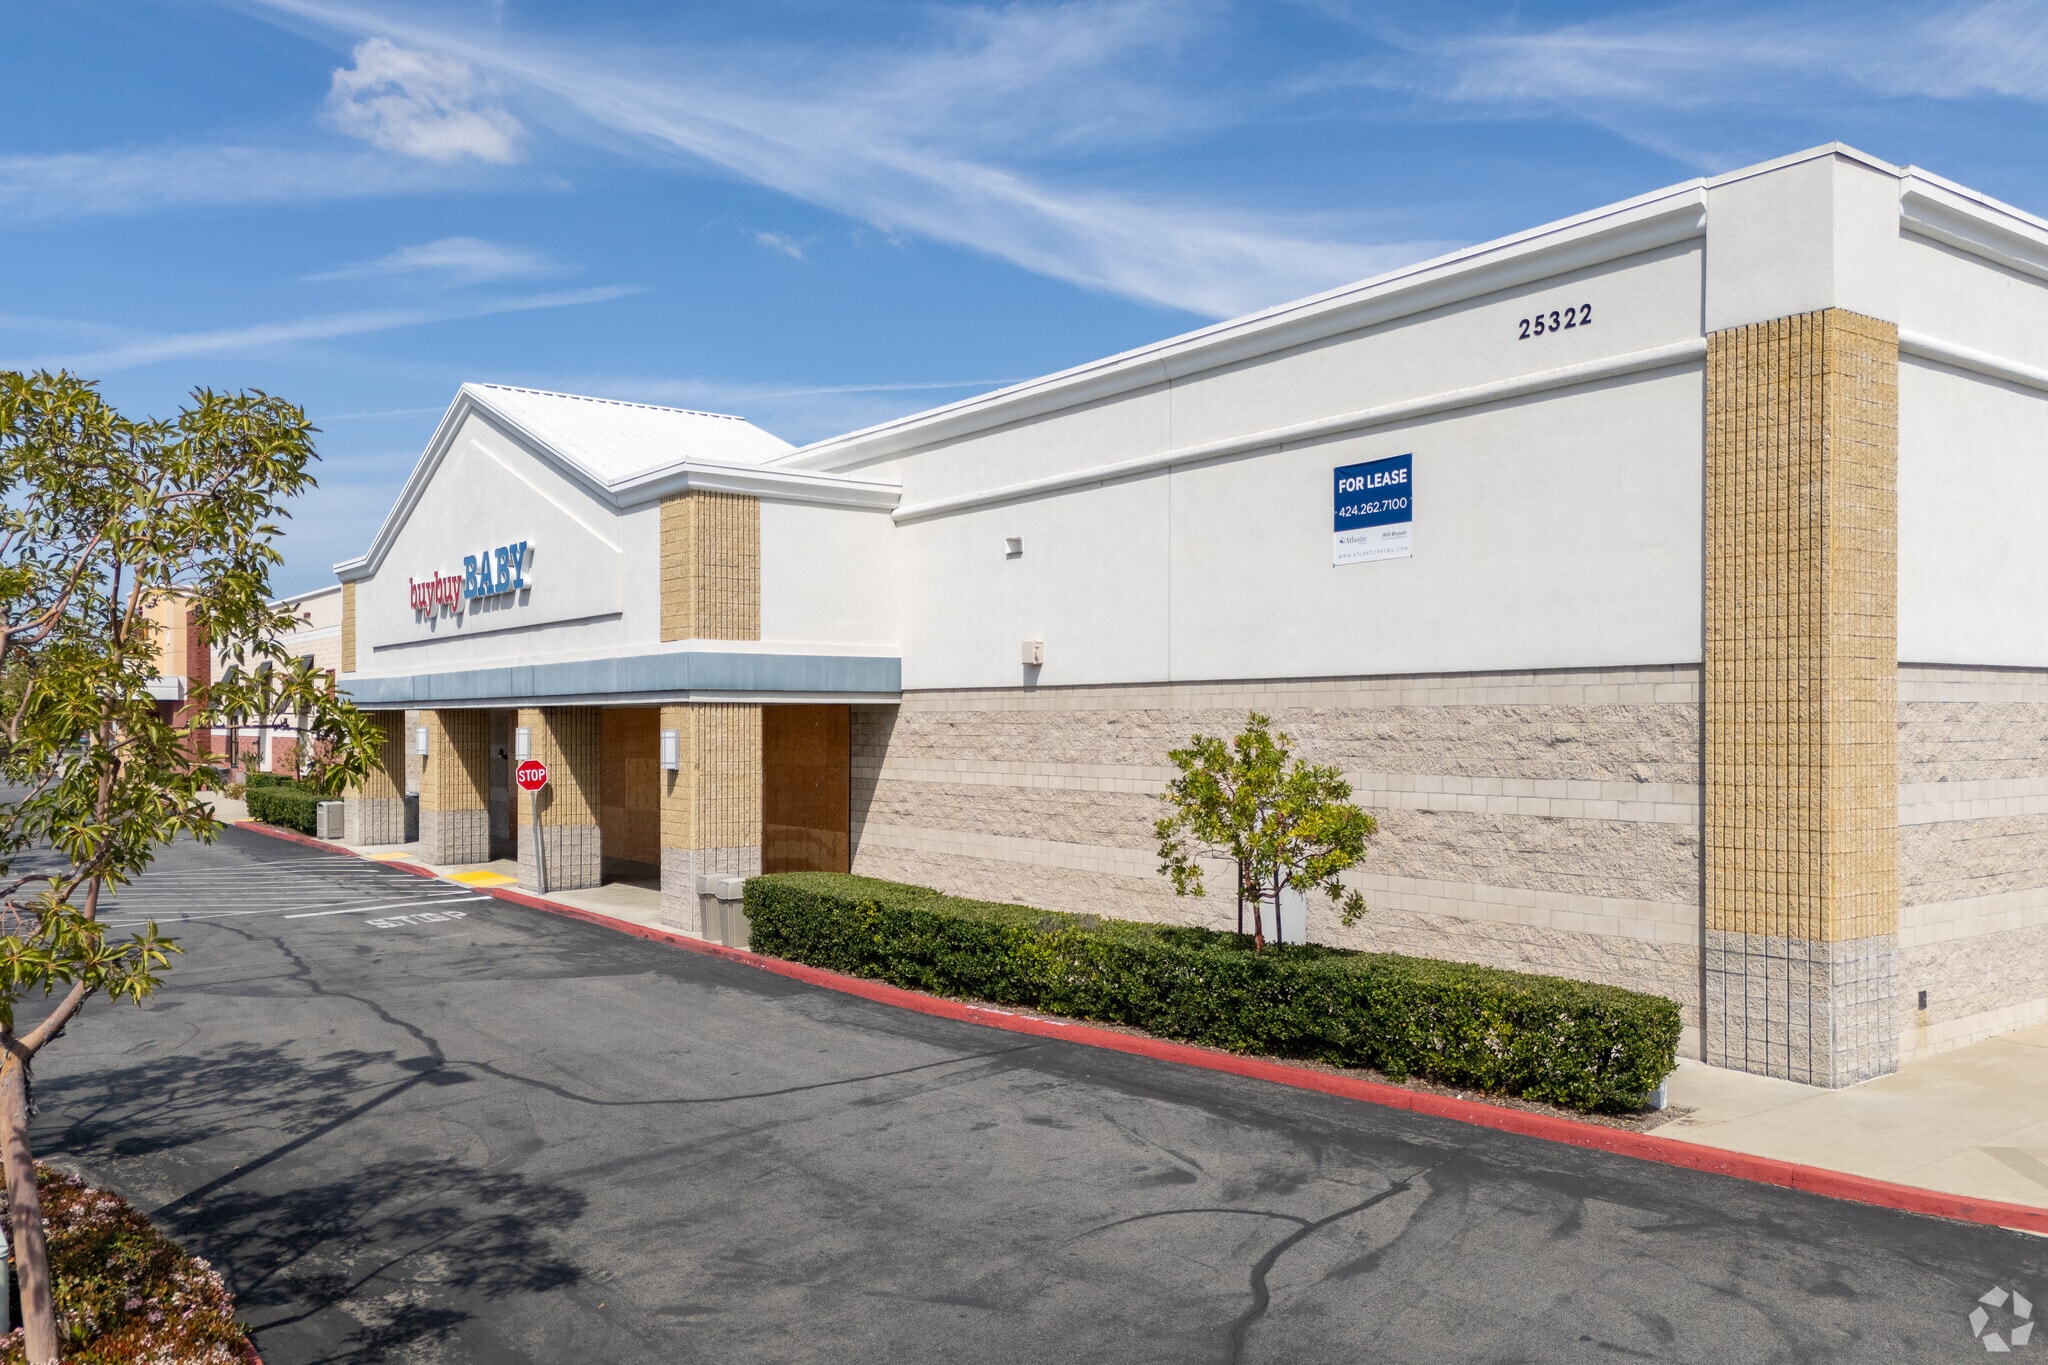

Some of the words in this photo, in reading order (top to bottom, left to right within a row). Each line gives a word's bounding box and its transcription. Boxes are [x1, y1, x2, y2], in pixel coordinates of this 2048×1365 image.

[1518, 303, 1592, 341] 25322
[1338, 475, 1364, 494] FOR
[1366, 468, 1408, 489] LEASE
[1338, 497, 1408, 518] 424.262.7100
[463, 540, 528, 600] BABY
[518, 768, 546, 782] STOP
